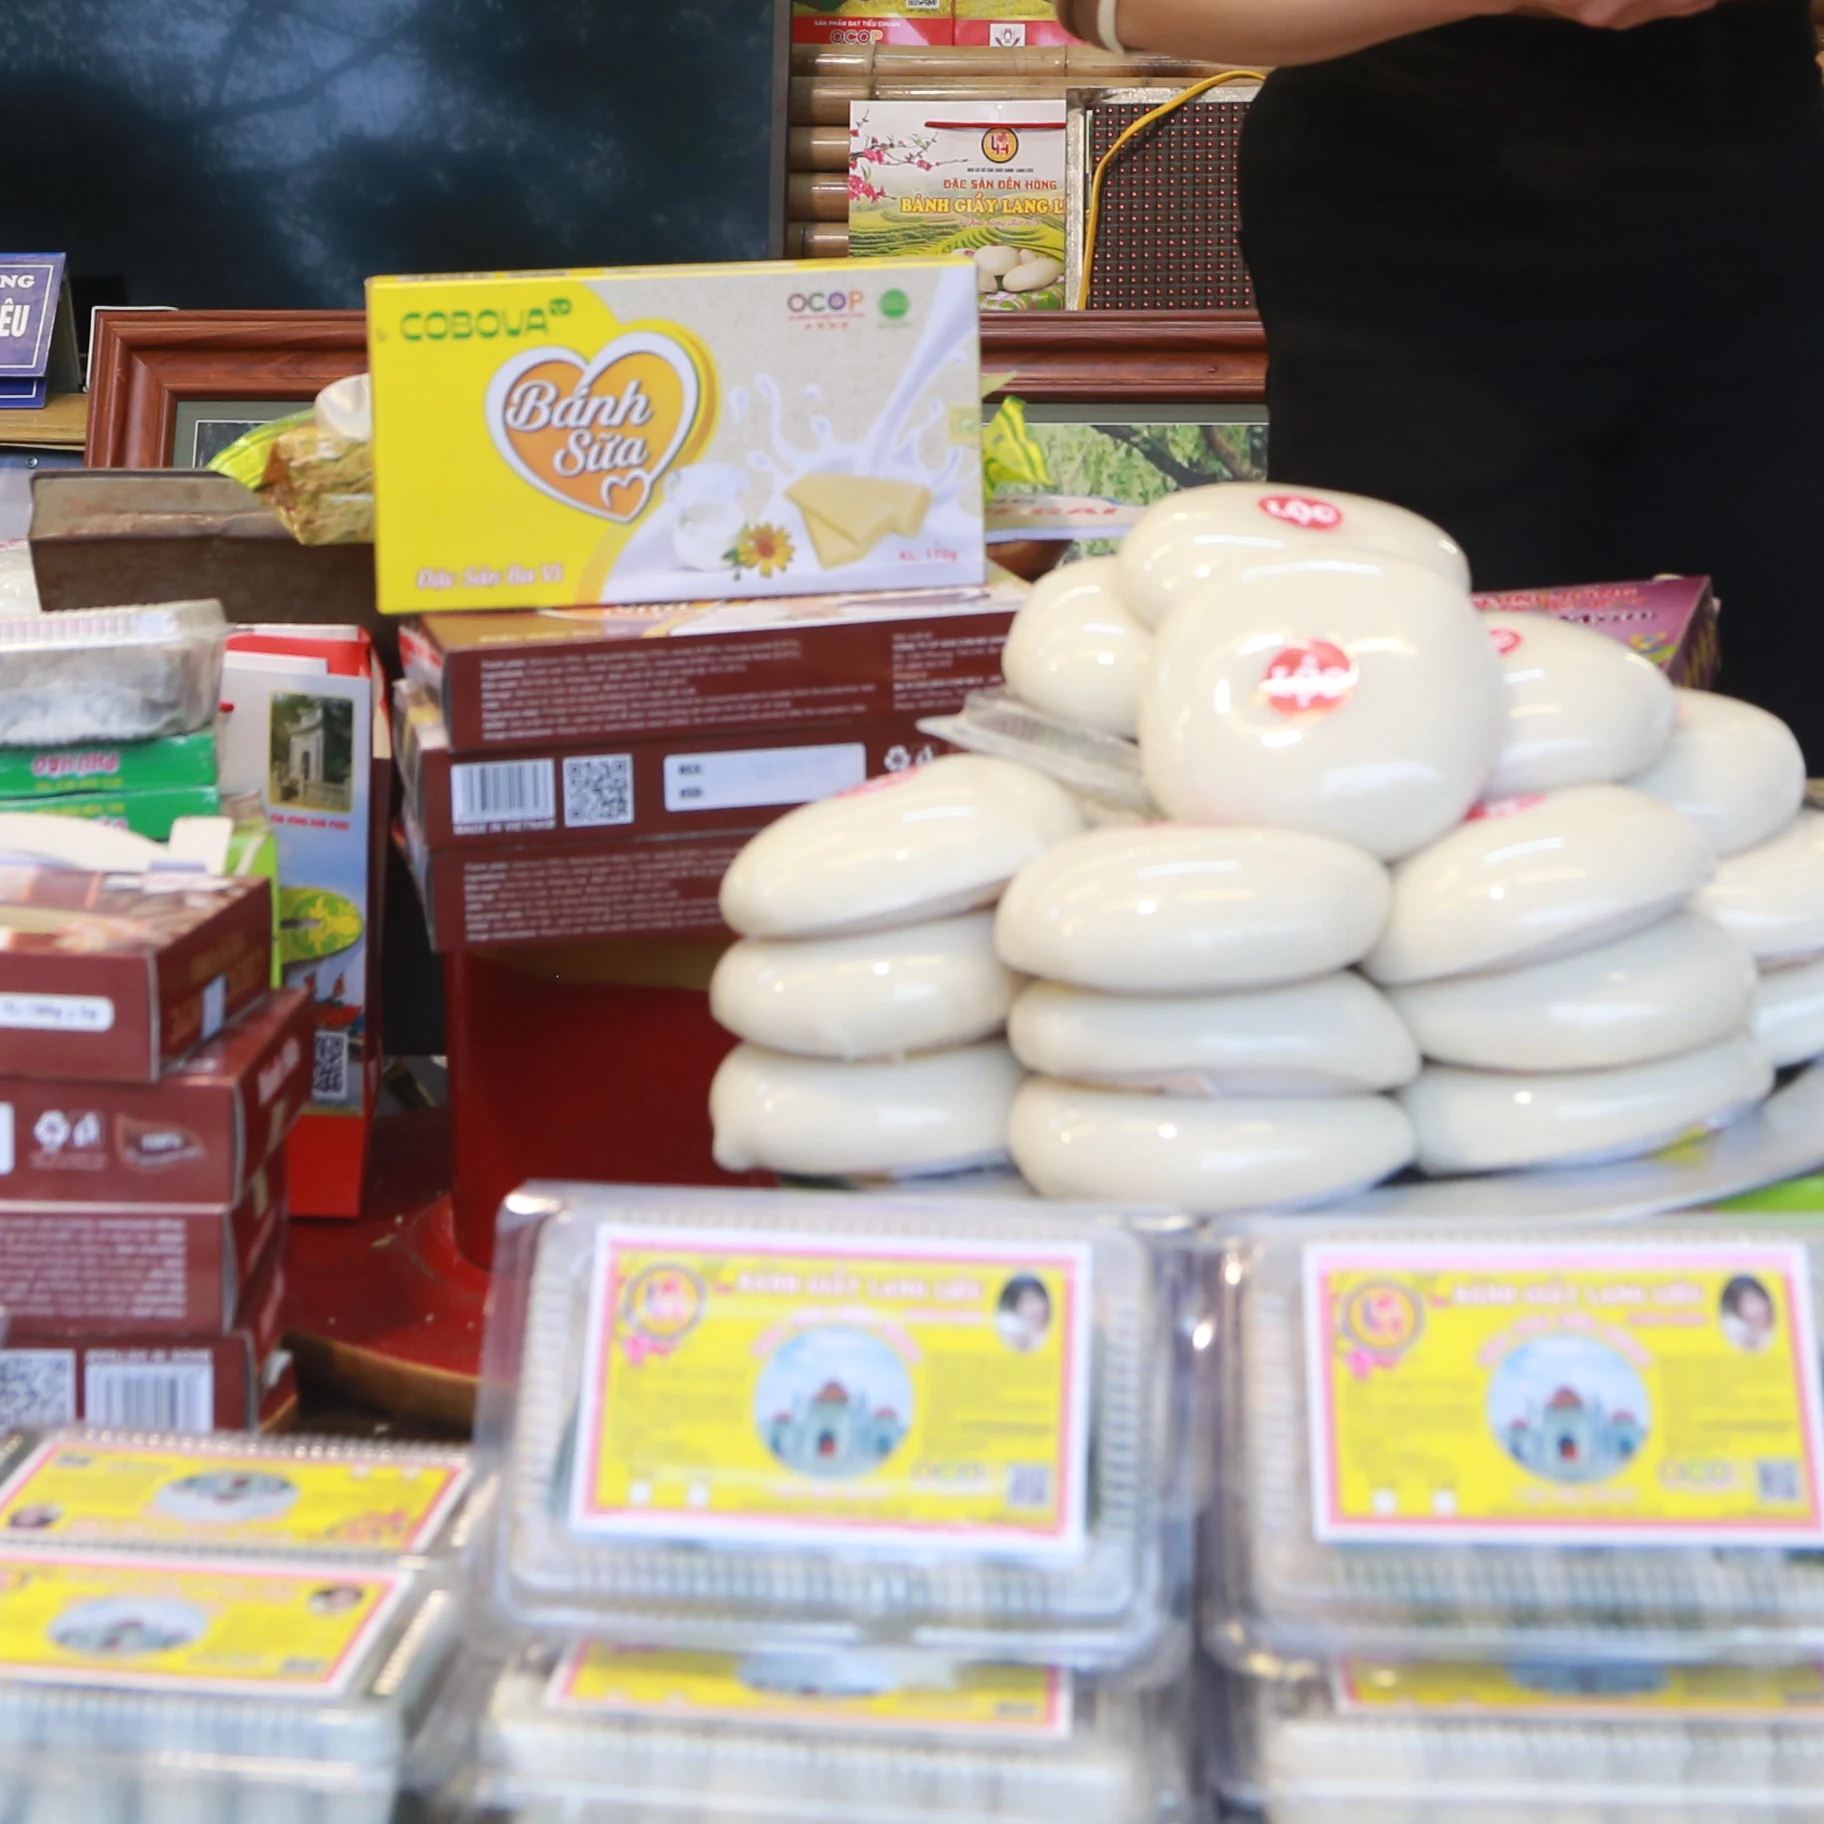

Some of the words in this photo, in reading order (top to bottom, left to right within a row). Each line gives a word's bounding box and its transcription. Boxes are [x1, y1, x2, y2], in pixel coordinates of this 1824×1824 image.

[787, 289, 866, 314] OCOP
[504, 379, 654, 432] Bánh
[552, 429, 650, 476] Sữa
